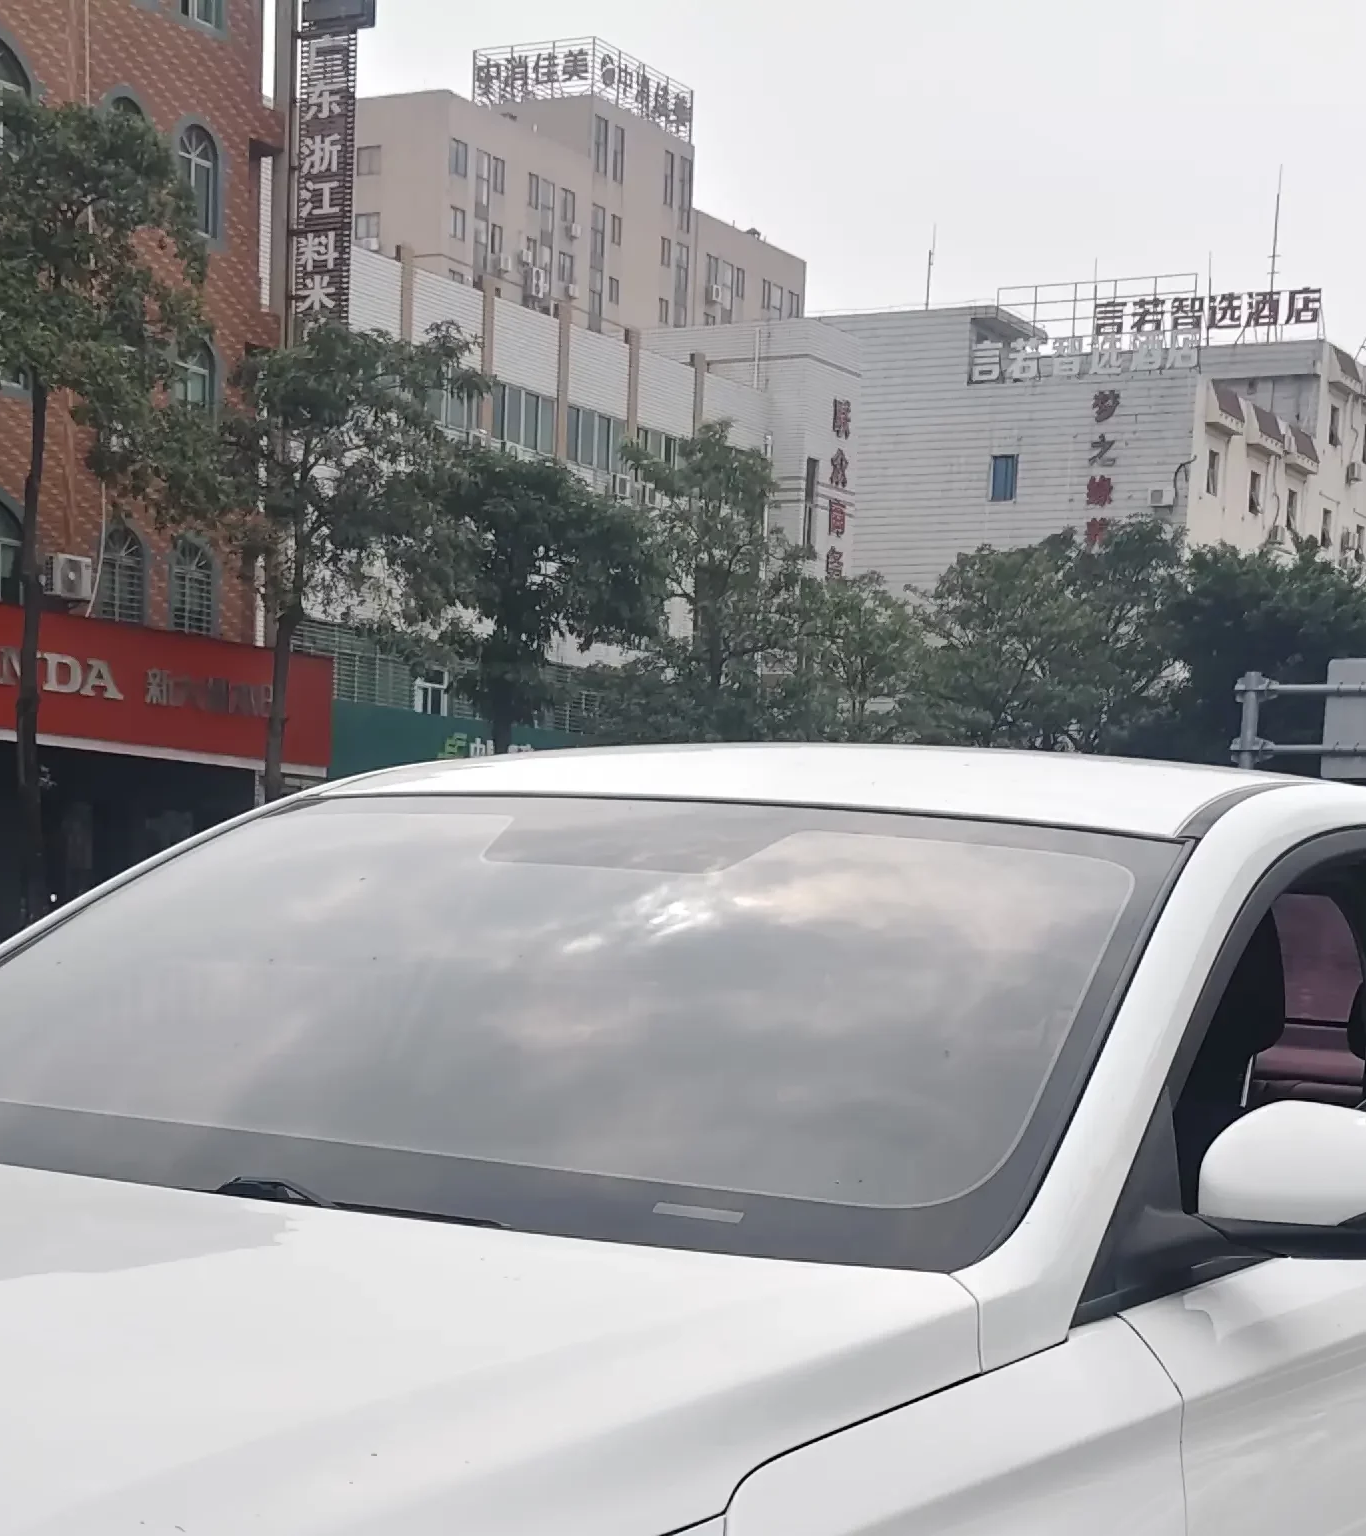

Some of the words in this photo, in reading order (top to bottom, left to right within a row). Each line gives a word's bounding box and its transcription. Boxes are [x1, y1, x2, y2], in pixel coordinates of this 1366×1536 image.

[972, 328, 1201, 383] 言若智选酒店
